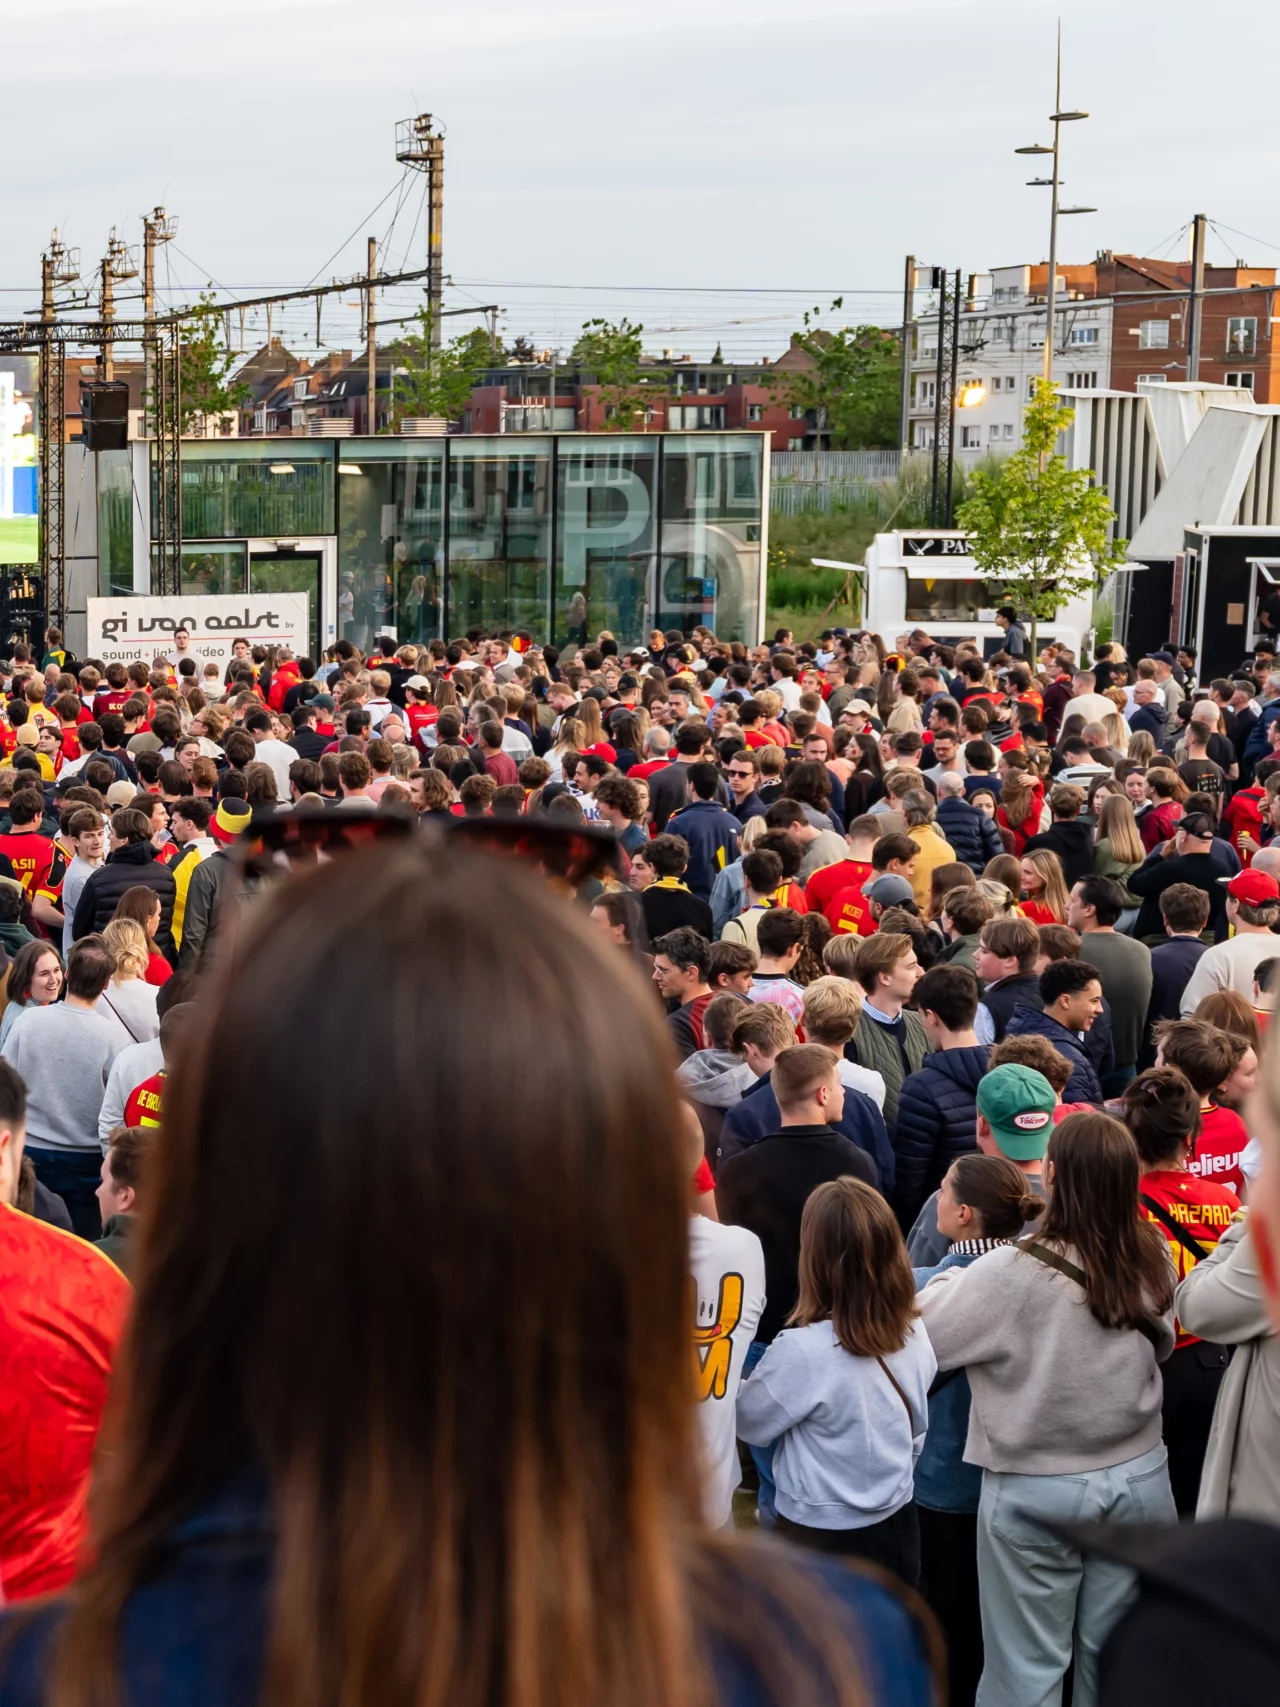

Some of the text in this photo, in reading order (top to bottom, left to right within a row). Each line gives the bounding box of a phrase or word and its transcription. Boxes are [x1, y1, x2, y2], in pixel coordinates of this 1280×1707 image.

[563, 467, 651, 586] P
[102, 611, 127, 642] gi
[138, 617, 196, 632] van
[205, 608, 279, 630] aalst
[102, 648, 141, 660] sound
[196, 646, 225, 657] ideo
[1020, 1116, 1045, 1124] Volcom
